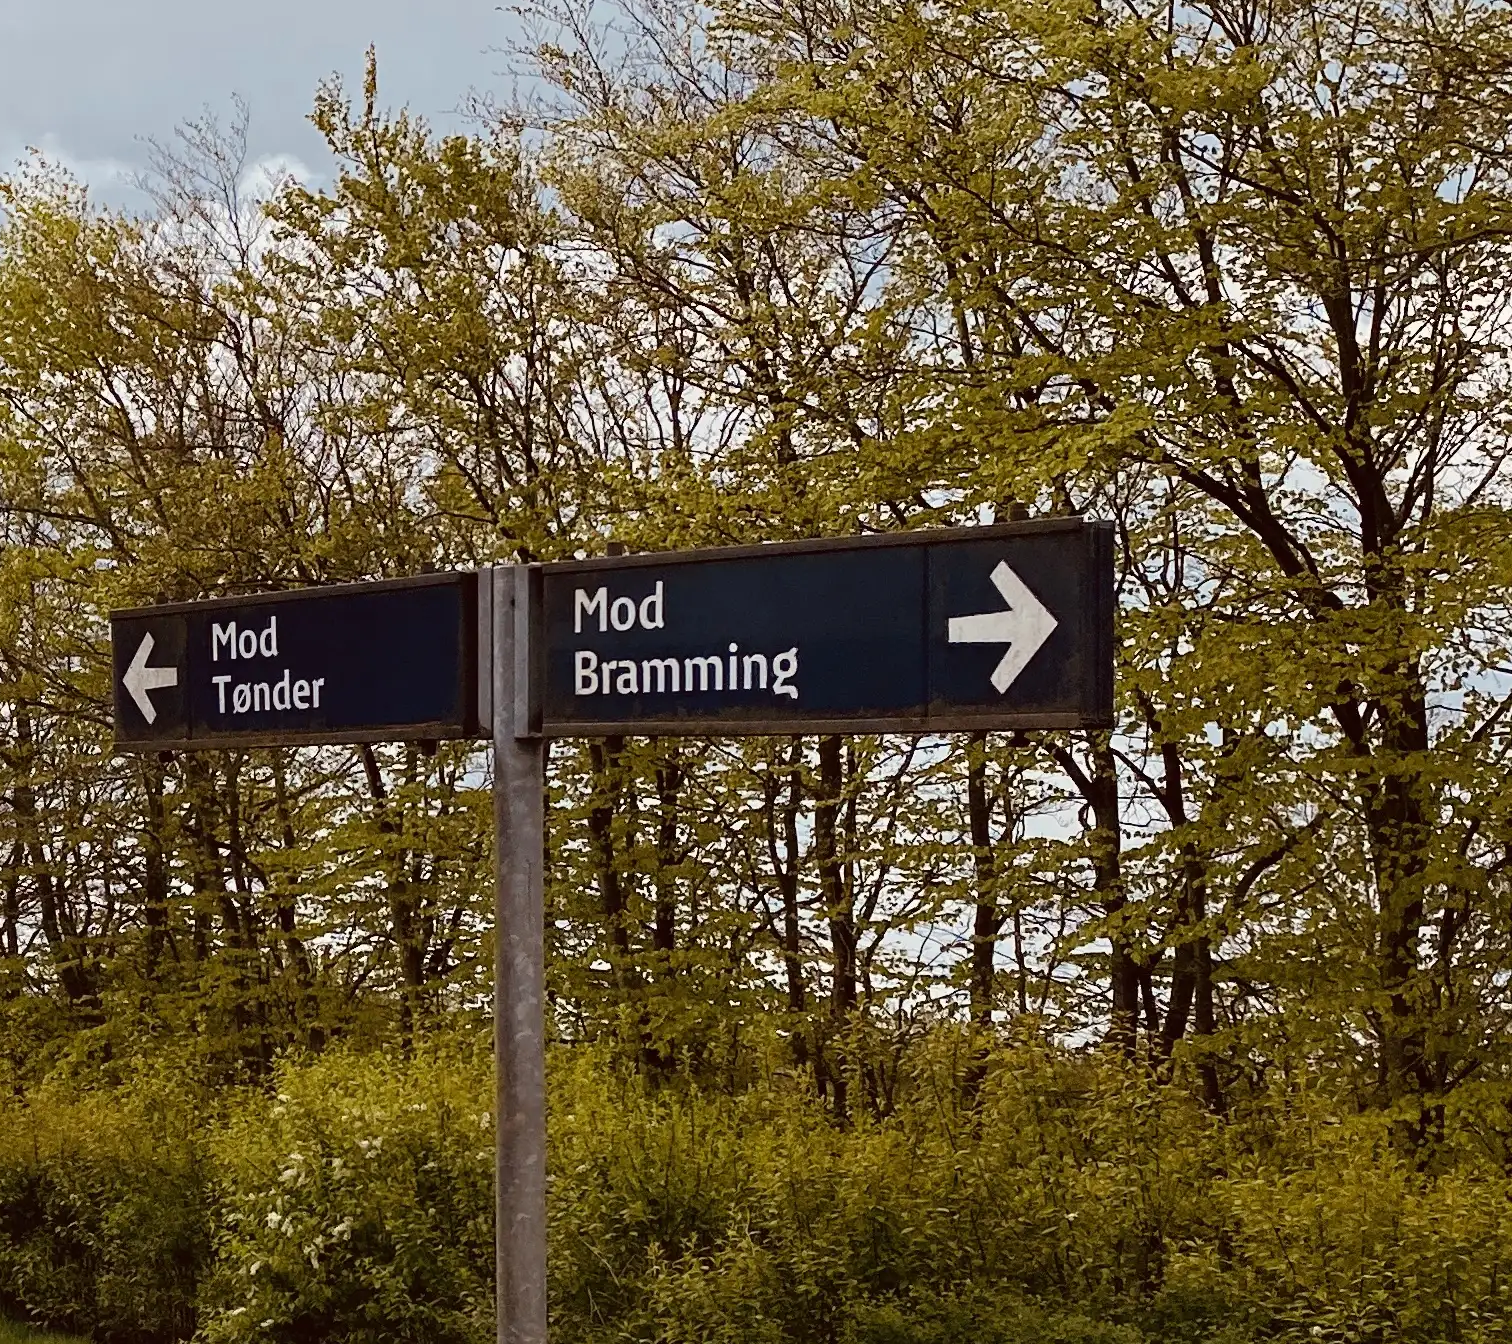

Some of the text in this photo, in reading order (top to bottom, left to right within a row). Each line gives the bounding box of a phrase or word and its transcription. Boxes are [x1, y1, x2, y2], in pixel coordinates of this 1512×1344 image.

[574, 580, 664, 633] Mod
[212, 616, 279, 661] Mod
[212, 669, 325, 714] Tønder
[574, 642, 798, 699] Bramming
